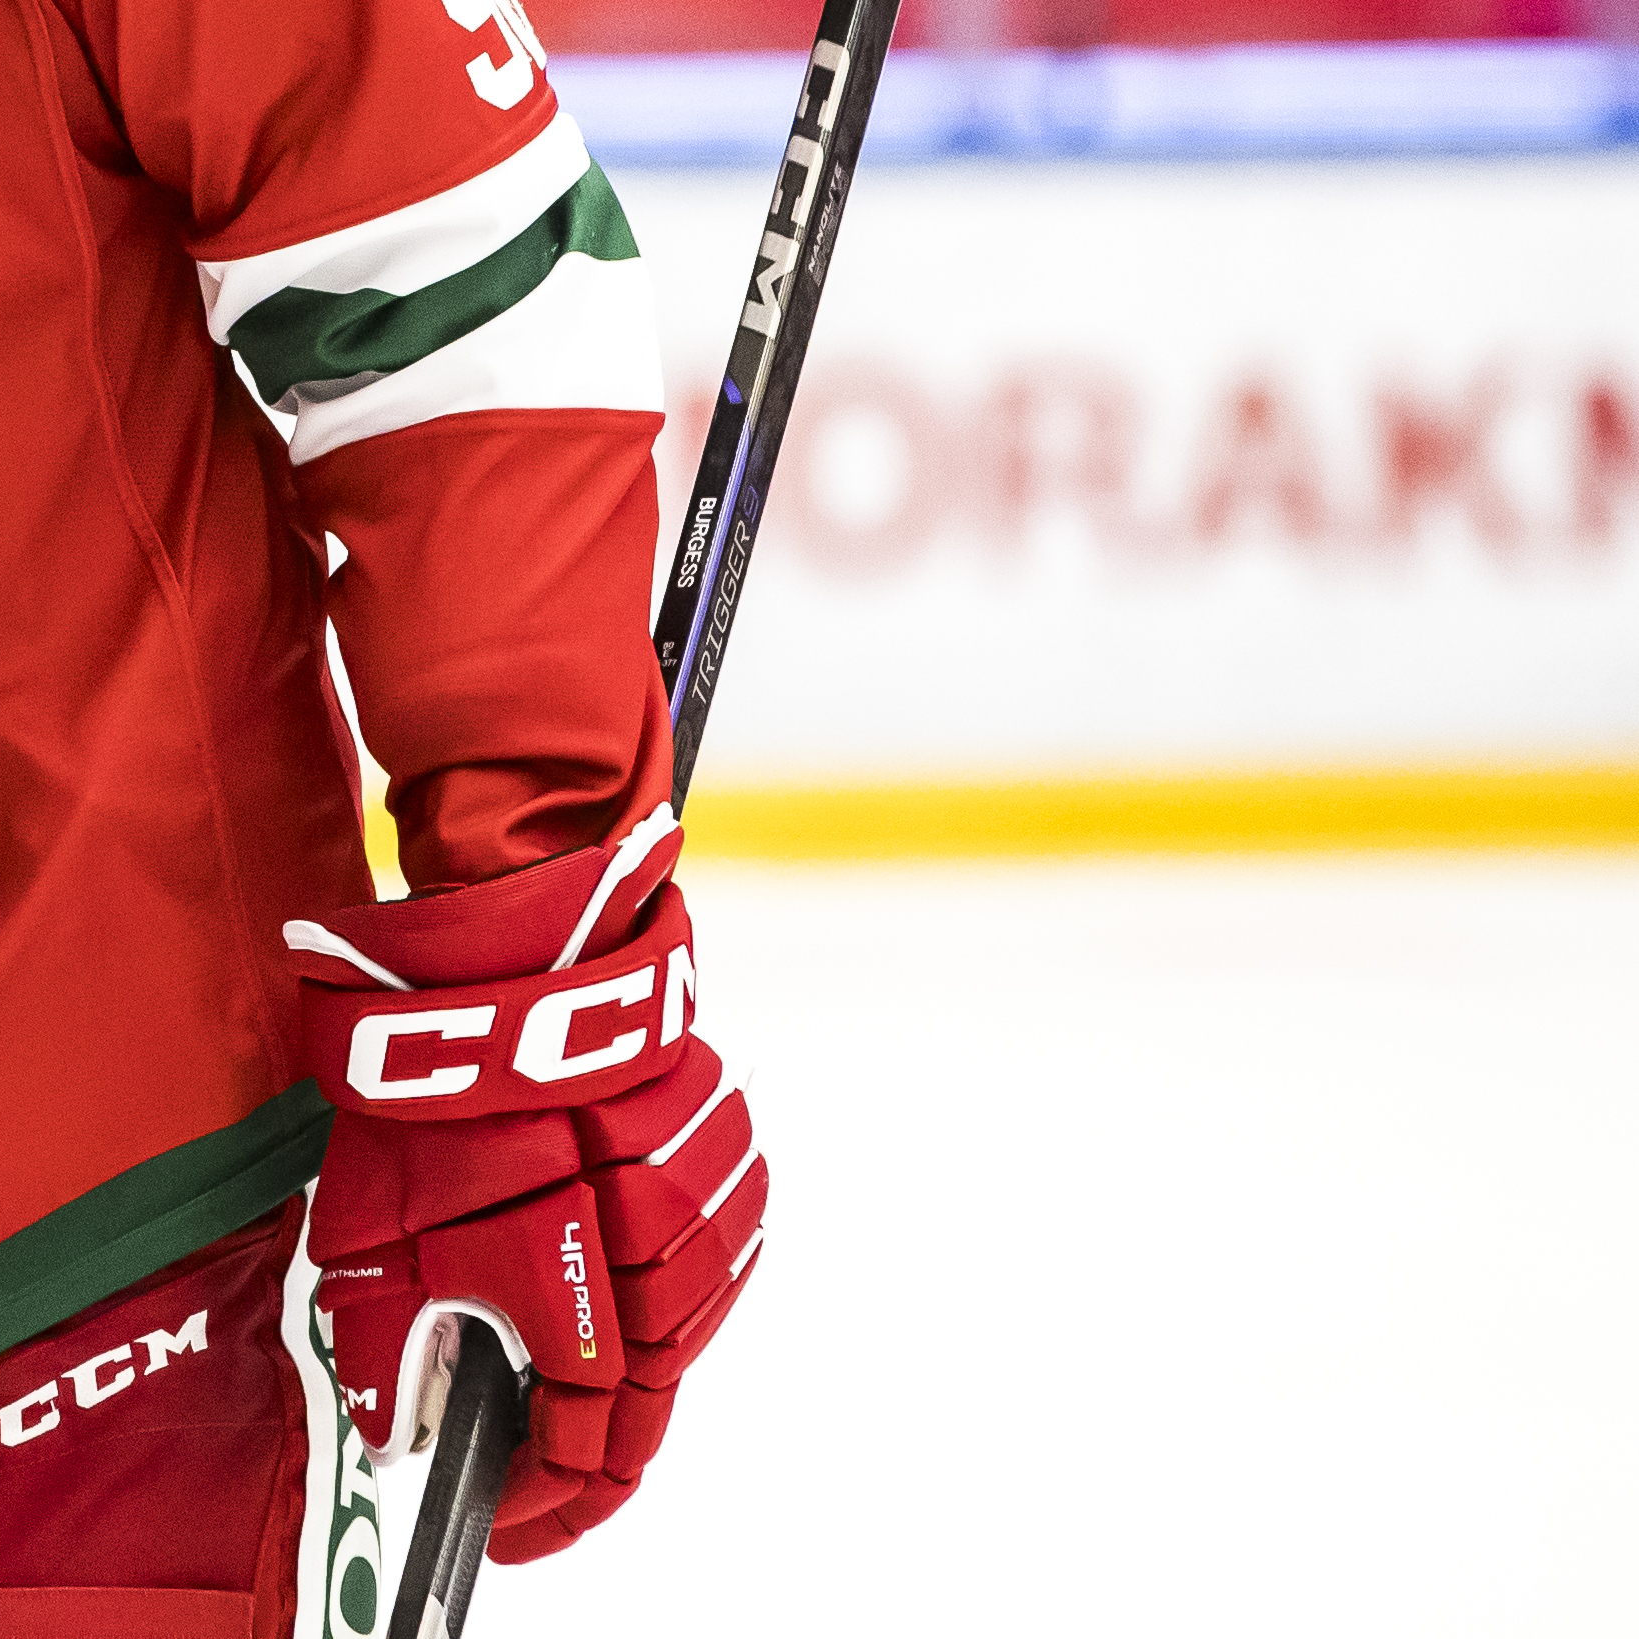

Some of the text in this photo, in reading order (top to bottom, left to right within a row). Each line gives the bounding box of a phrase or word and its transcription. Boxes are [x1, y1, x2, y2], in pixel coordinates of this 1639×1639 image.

[739, 38, 851, 341] CCM
[677, 497, 718, 589] BURGESS
[692, 519, 750, 705] TRIGGER
